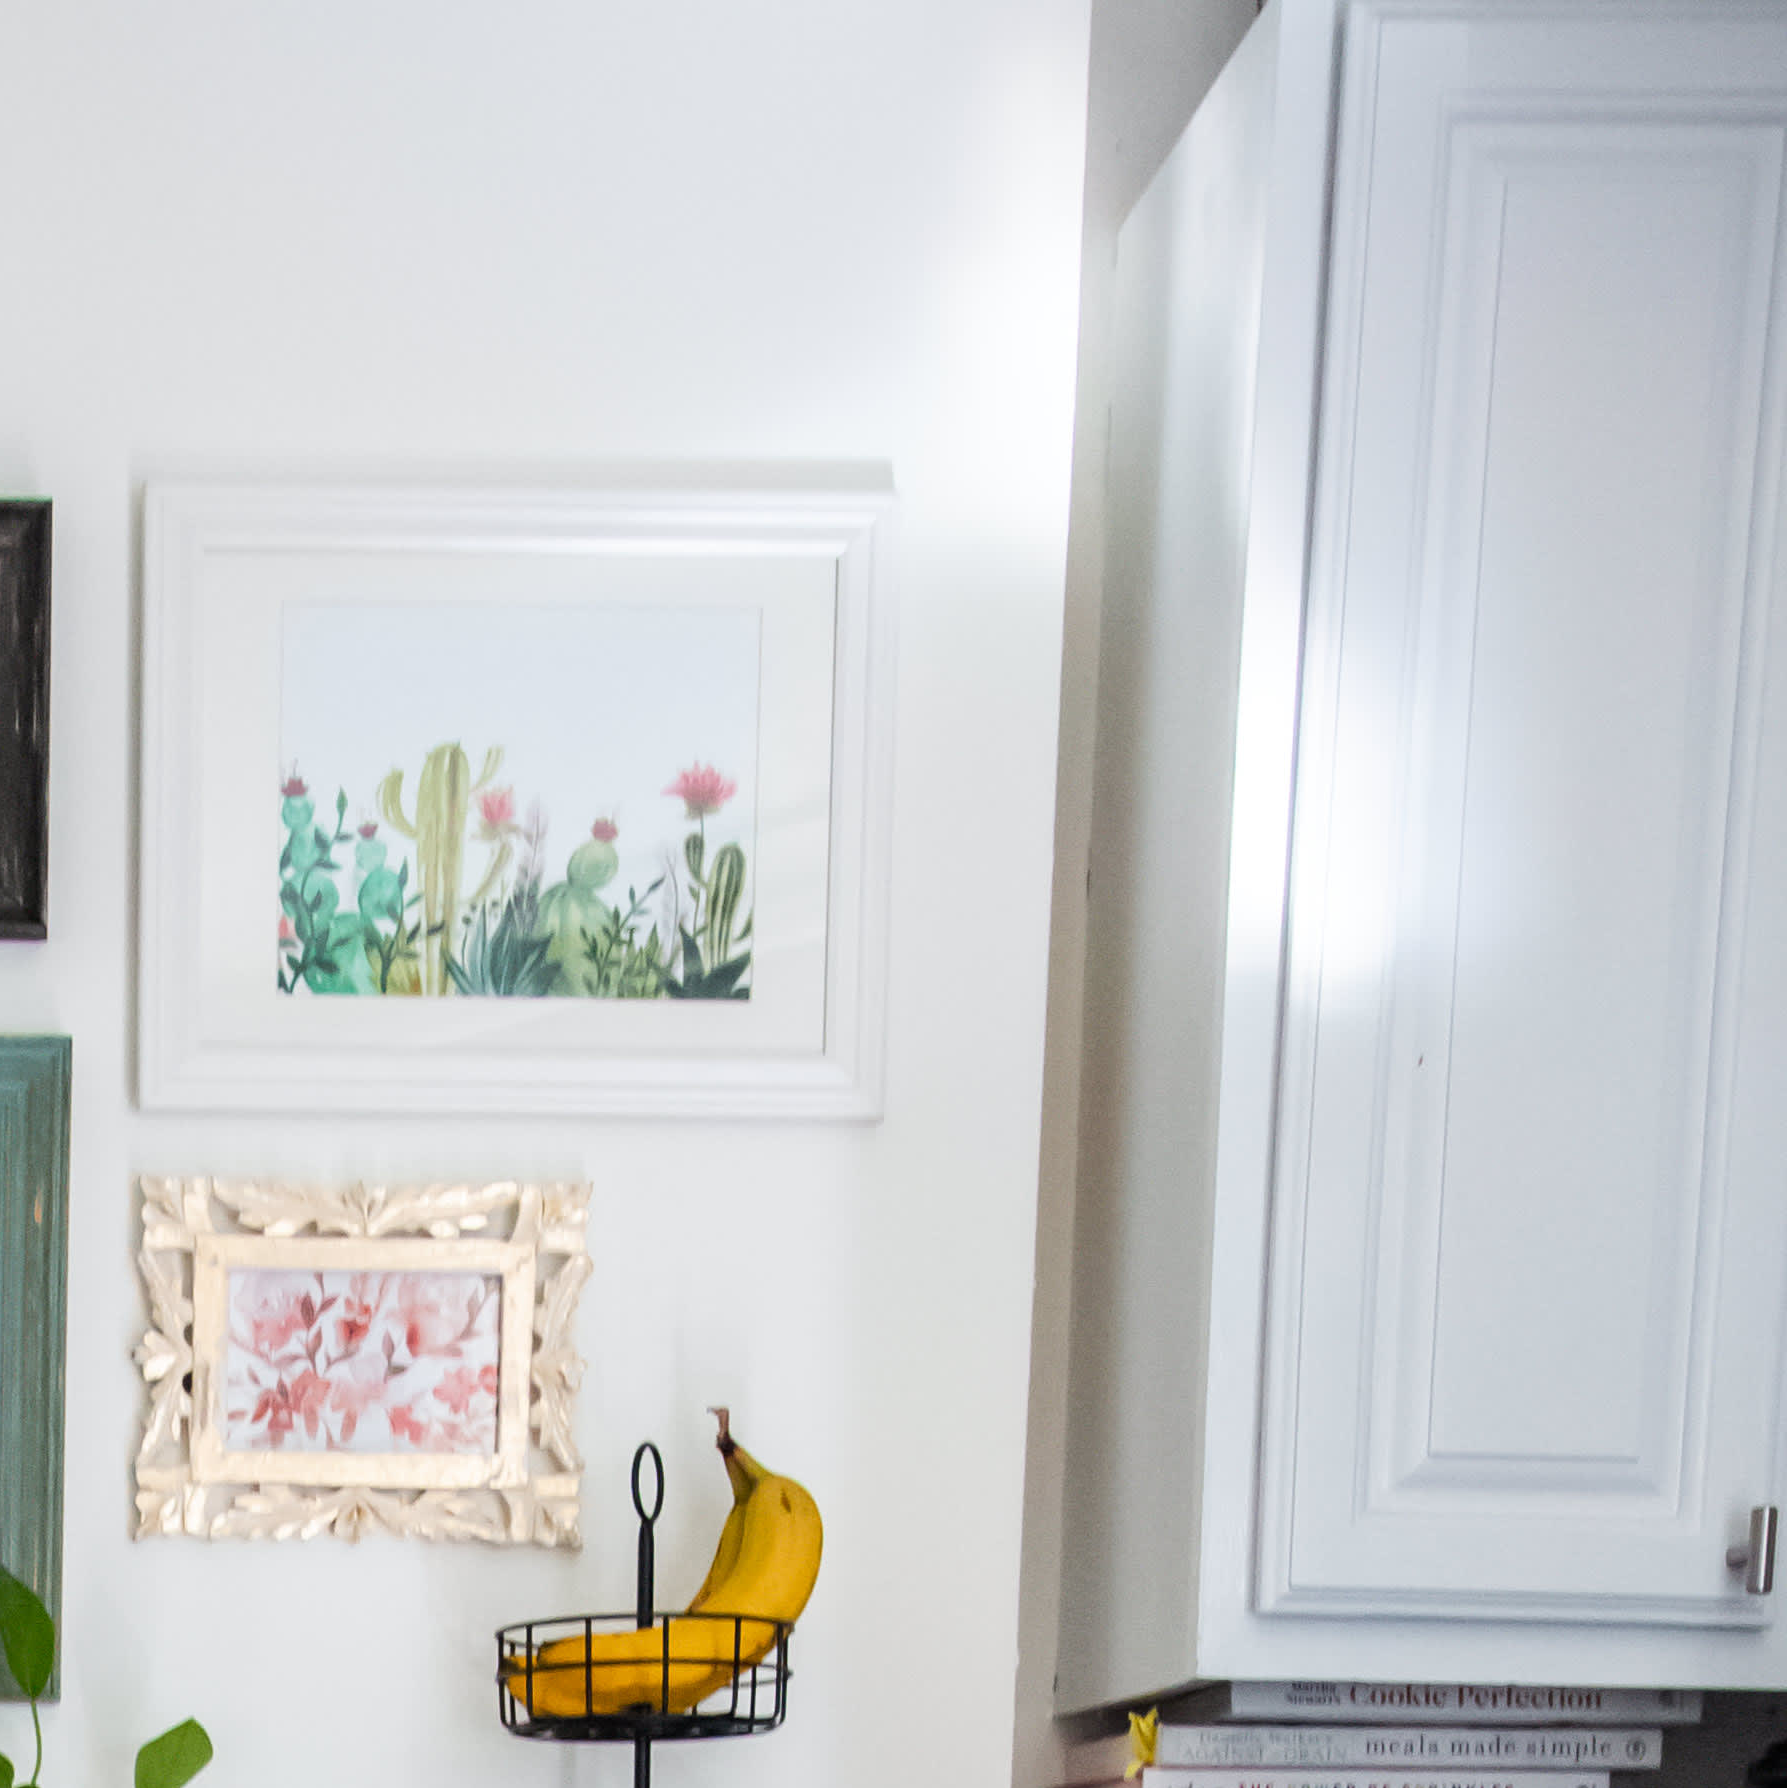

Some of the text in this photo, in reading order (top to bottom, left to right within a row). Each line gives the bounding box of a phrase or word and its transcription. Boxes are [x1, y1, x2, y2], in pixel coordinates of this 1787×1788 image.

[1349, 1683, 1445, 1709] Cookie
[1365, 1733, 1612, 1763] meals made simple
